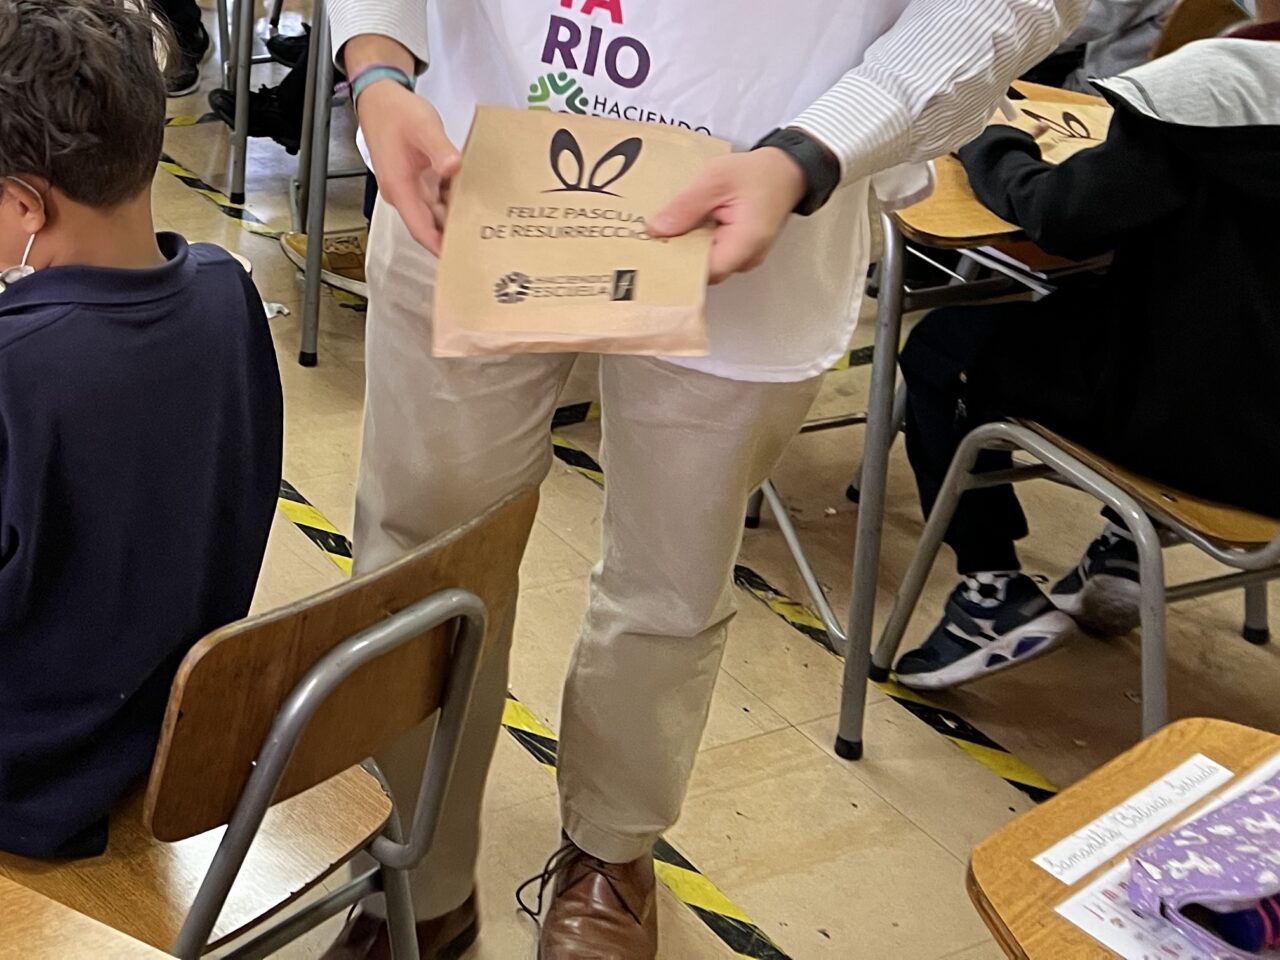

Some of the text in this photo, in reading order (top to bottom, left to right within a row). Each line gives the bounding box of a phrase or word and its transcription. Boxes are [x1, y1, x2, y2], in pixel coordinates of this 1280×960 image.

[540, 13, 652, 90] RIO
[506, 206, 646, 224] FELIZ PASCUA
[480, 225, 507, 240] DE
